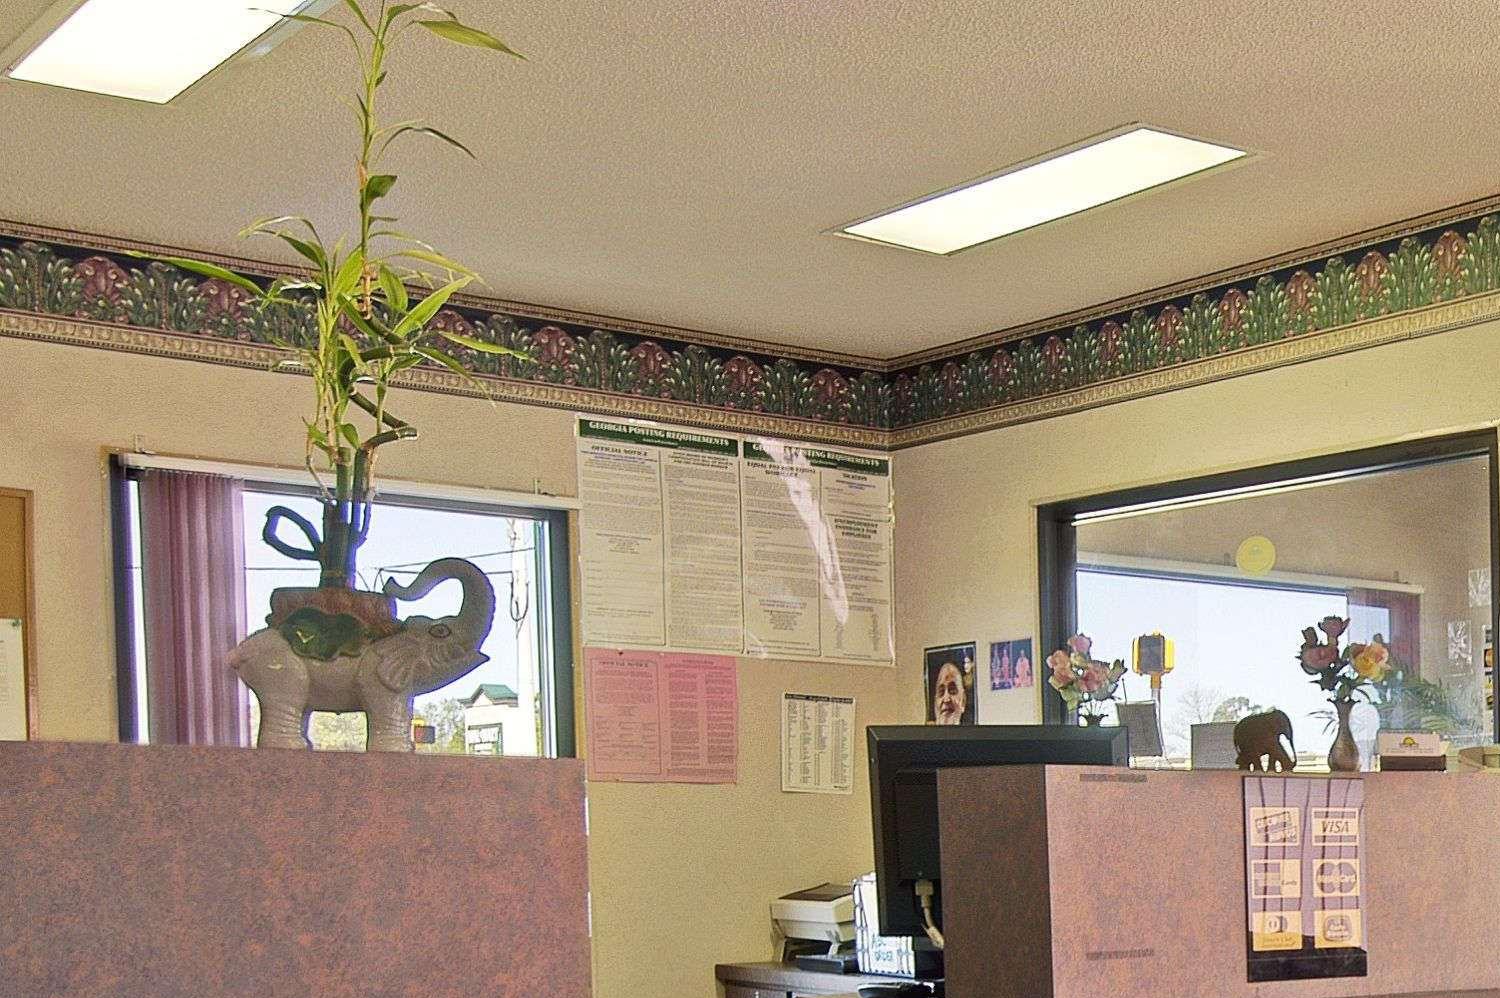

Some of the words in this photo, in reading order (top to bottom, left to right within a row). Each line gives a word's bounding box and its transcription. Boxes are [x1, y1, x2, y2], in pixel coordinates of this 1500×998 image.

[589, 420, 627, 434] GEORGIA
[629, 425, 665, 438] POSTING
[666, 430, 730, 447] REQUIREMENTS
[1321, 821, 1351, 833] VISA
